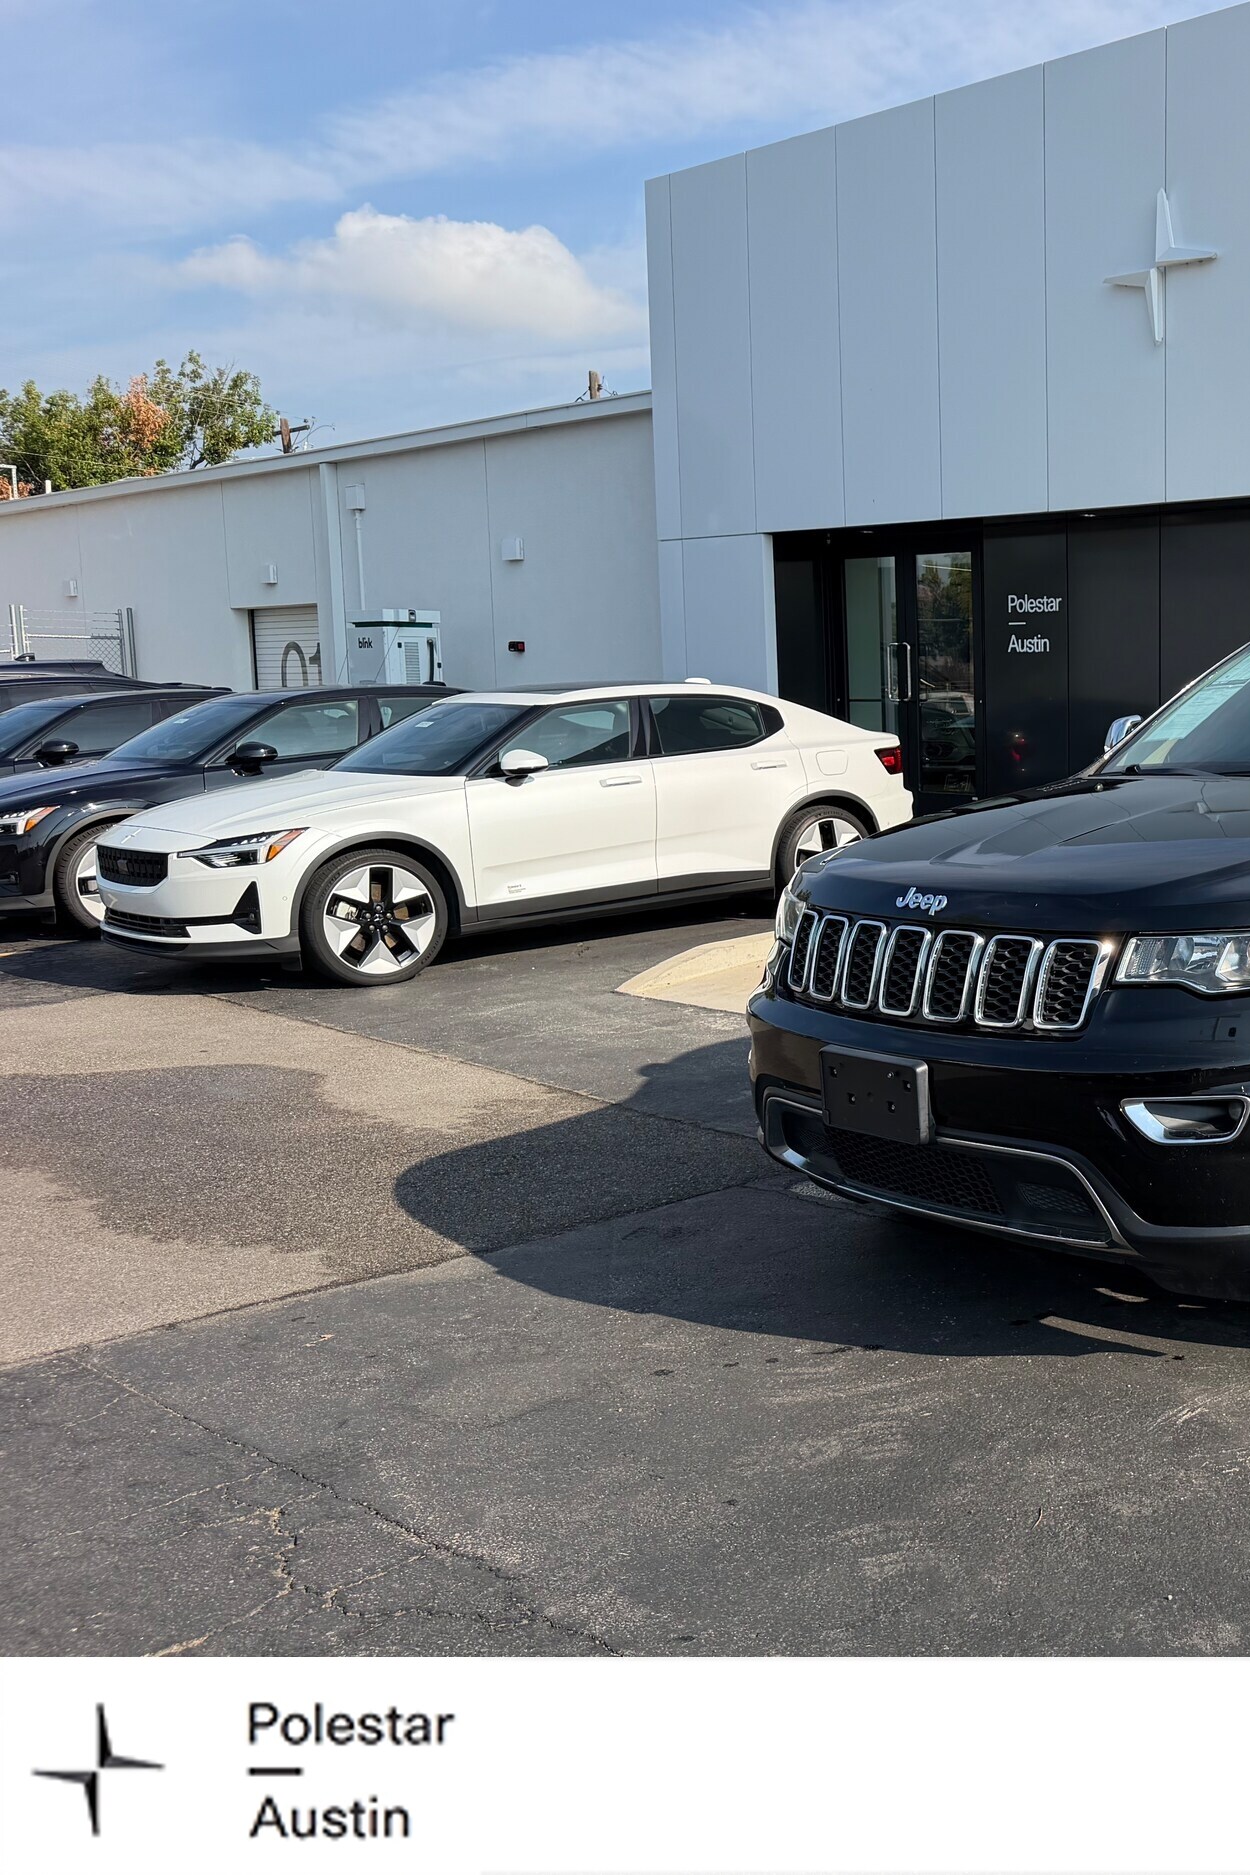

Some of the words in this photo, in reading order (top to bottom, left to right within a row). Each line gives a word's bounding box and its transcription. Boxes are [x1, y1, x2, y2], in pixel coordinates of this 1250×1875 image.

[1007, 594, 1062, 613] Polestar
[357, 637, 373, 649] blink
[1007, 634, 1050, 653] Austin
[895, 886, 948, 916] Jeep
